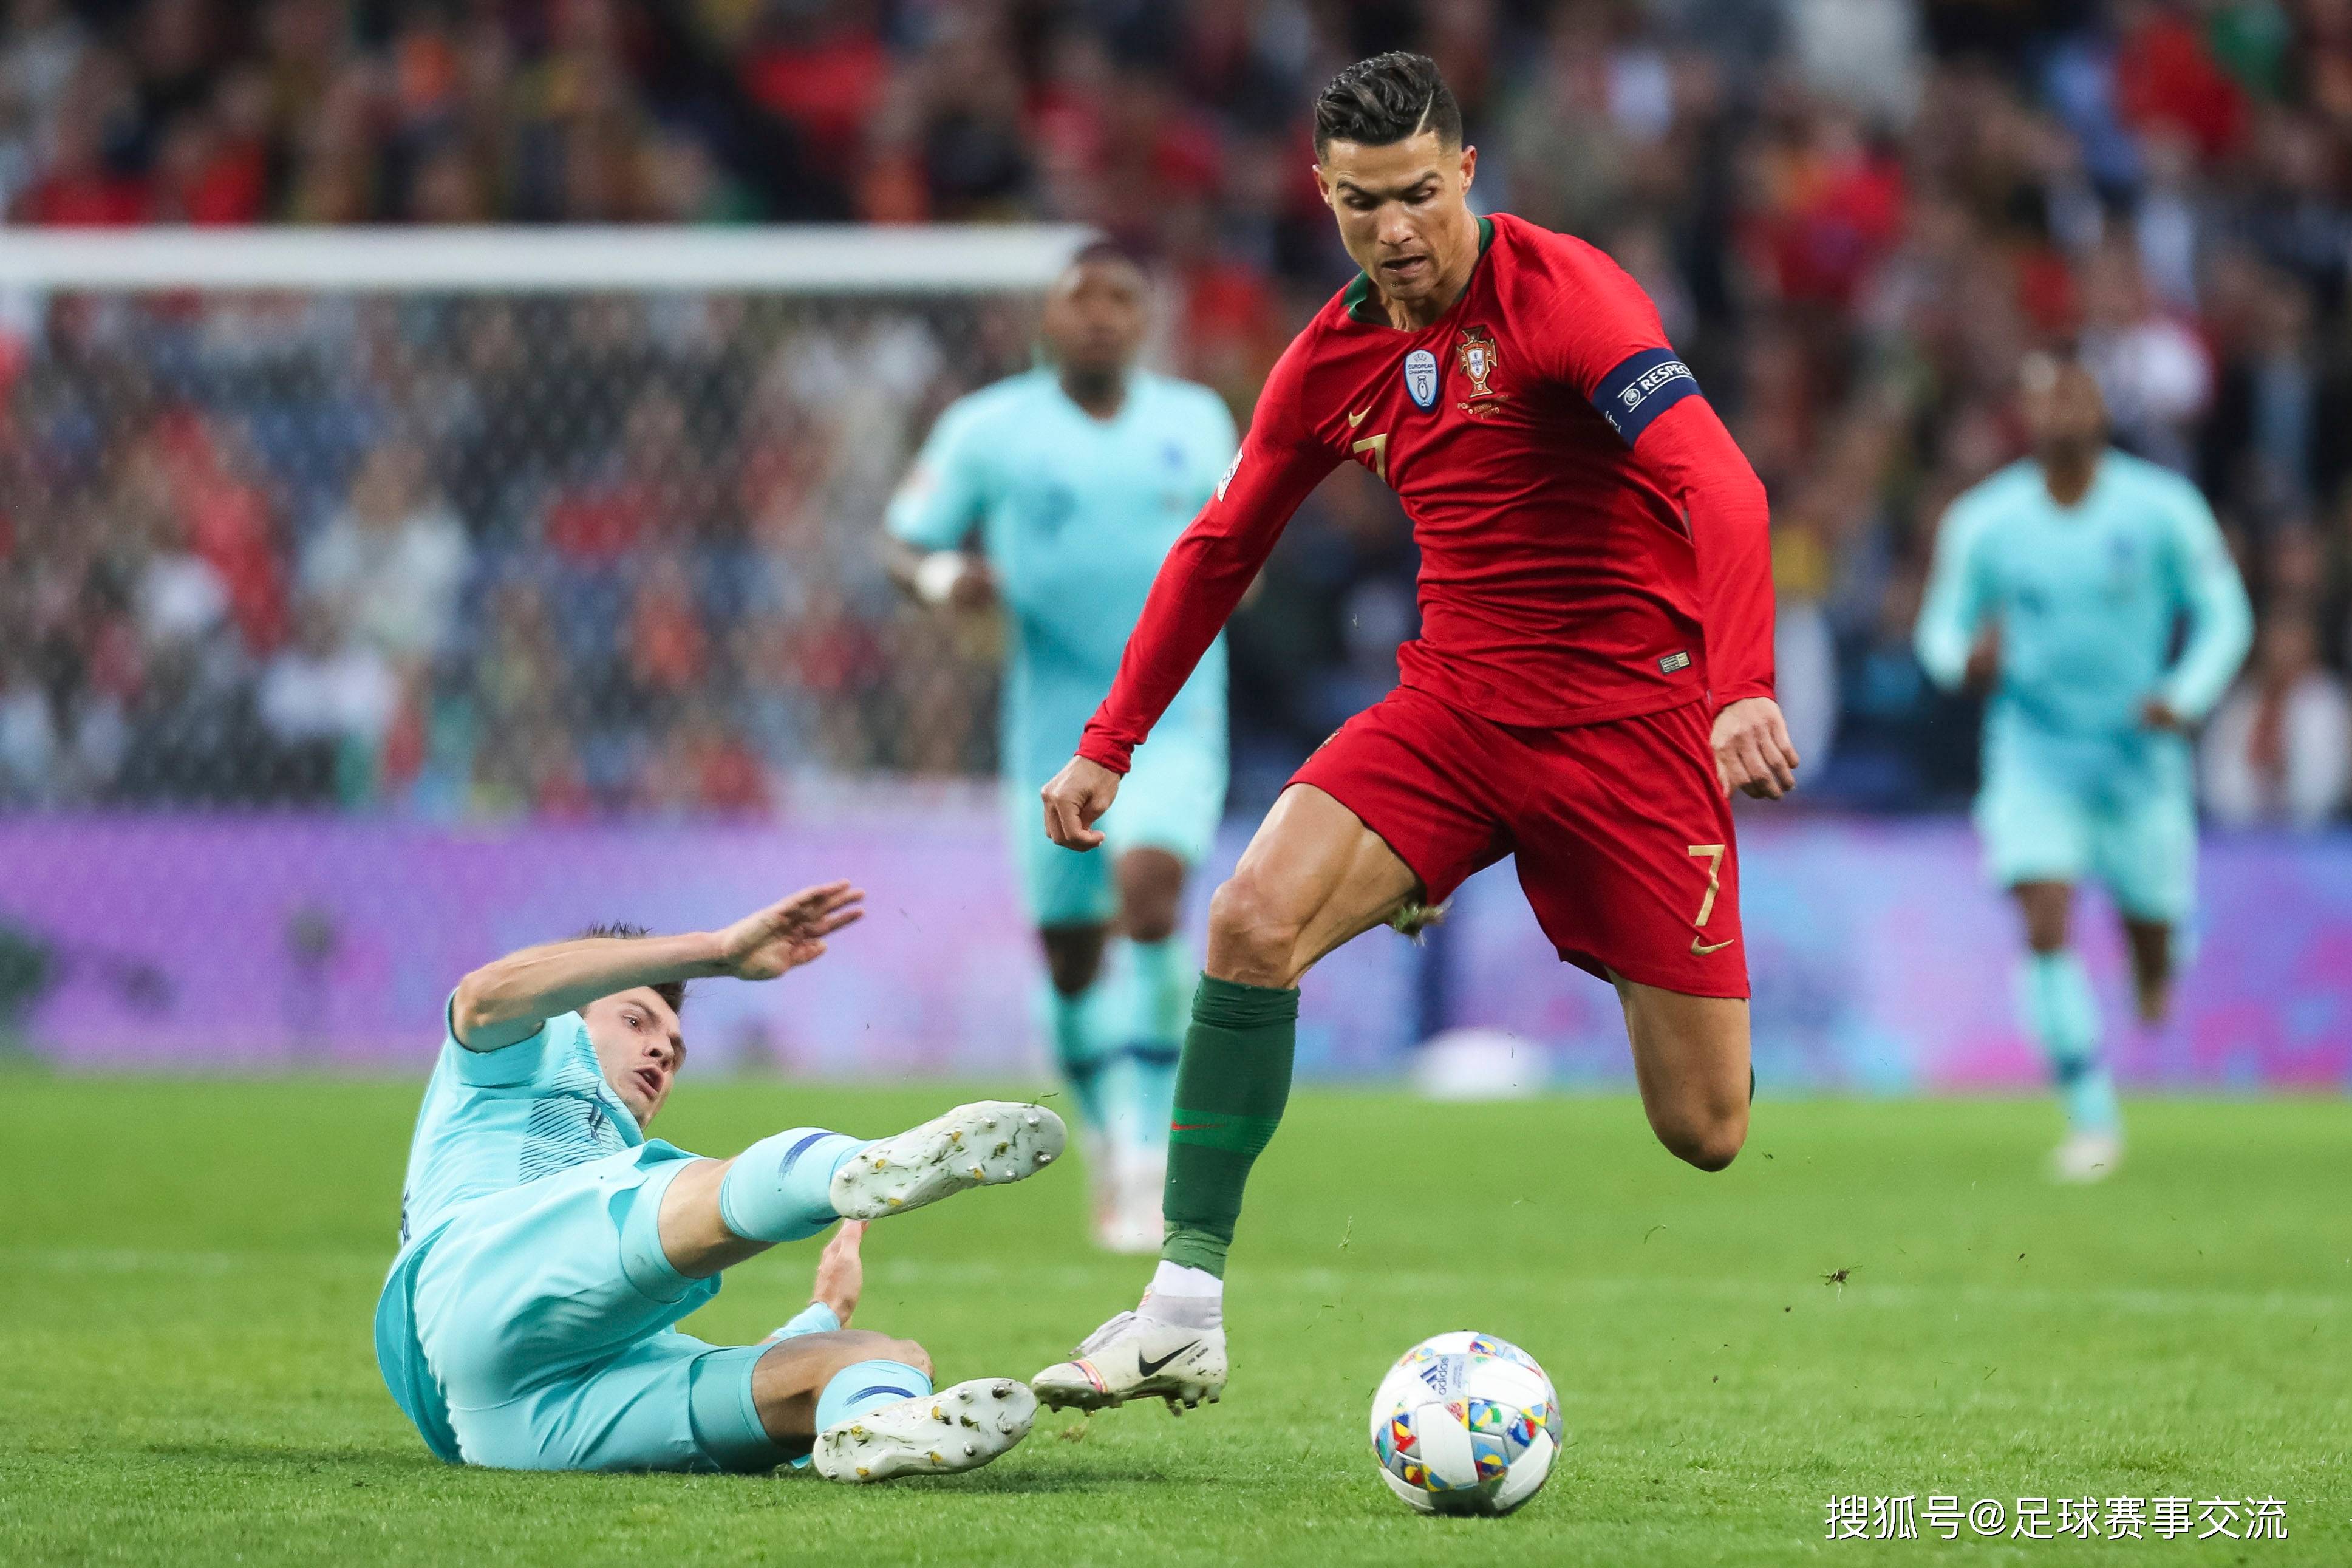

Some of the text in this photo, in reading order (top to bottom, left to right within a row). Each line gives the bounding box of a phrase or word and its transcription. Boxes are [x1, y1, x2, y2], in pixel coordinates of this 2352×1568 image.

[1640, 364, 1693, 390] RESPEC
[1352, 433, 1388, 482] 7
[1688, 844, 1725, 927] 7
[1438, 1357, 1449, 1395] adidas
